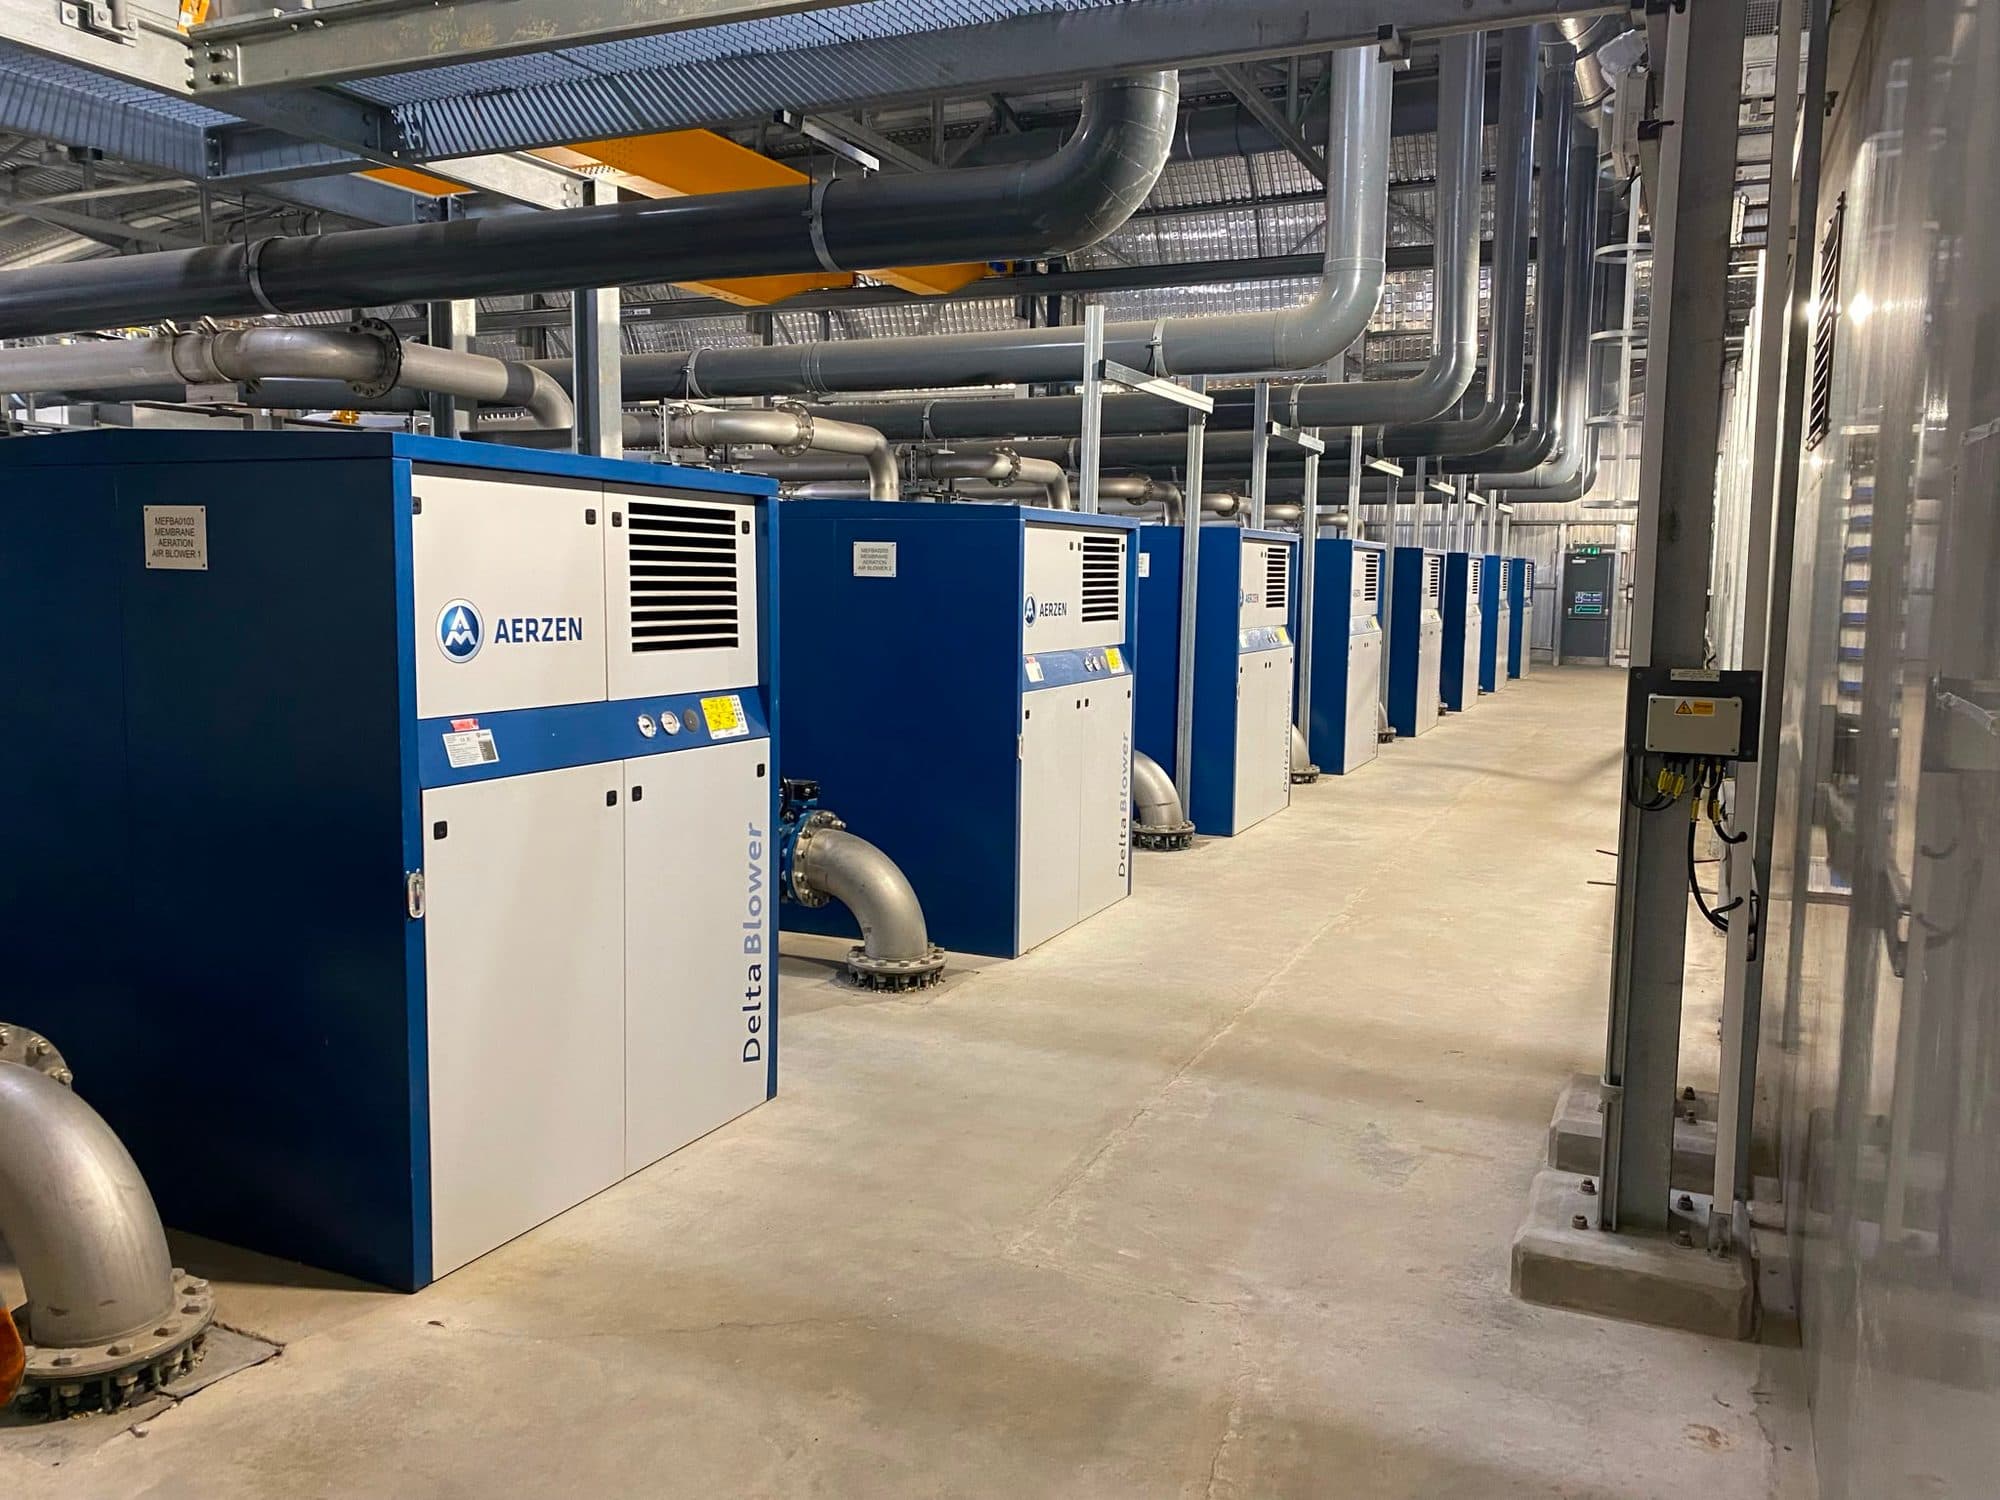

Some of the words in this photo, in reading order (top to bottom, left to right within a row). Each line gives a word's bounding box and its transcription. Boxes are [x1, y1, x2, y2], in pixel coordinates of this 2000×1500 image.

[155, 528, 195, 537] MEMBRANE
[158, 539, 194, 547] AERATION
[152, 549, 164, 558] AIR
[165, 550, 196, 559] BLOWER
[1039, 602, 1067, 617] AERZEN
[494, 617, 583, 644] AERZEN
[1119, 732, 1129, 812] Blower
[1118, 818, 1126, 877] Delta
[742, 822, 762, 954] Blower
[742, 964, 761, 1063] Delta
